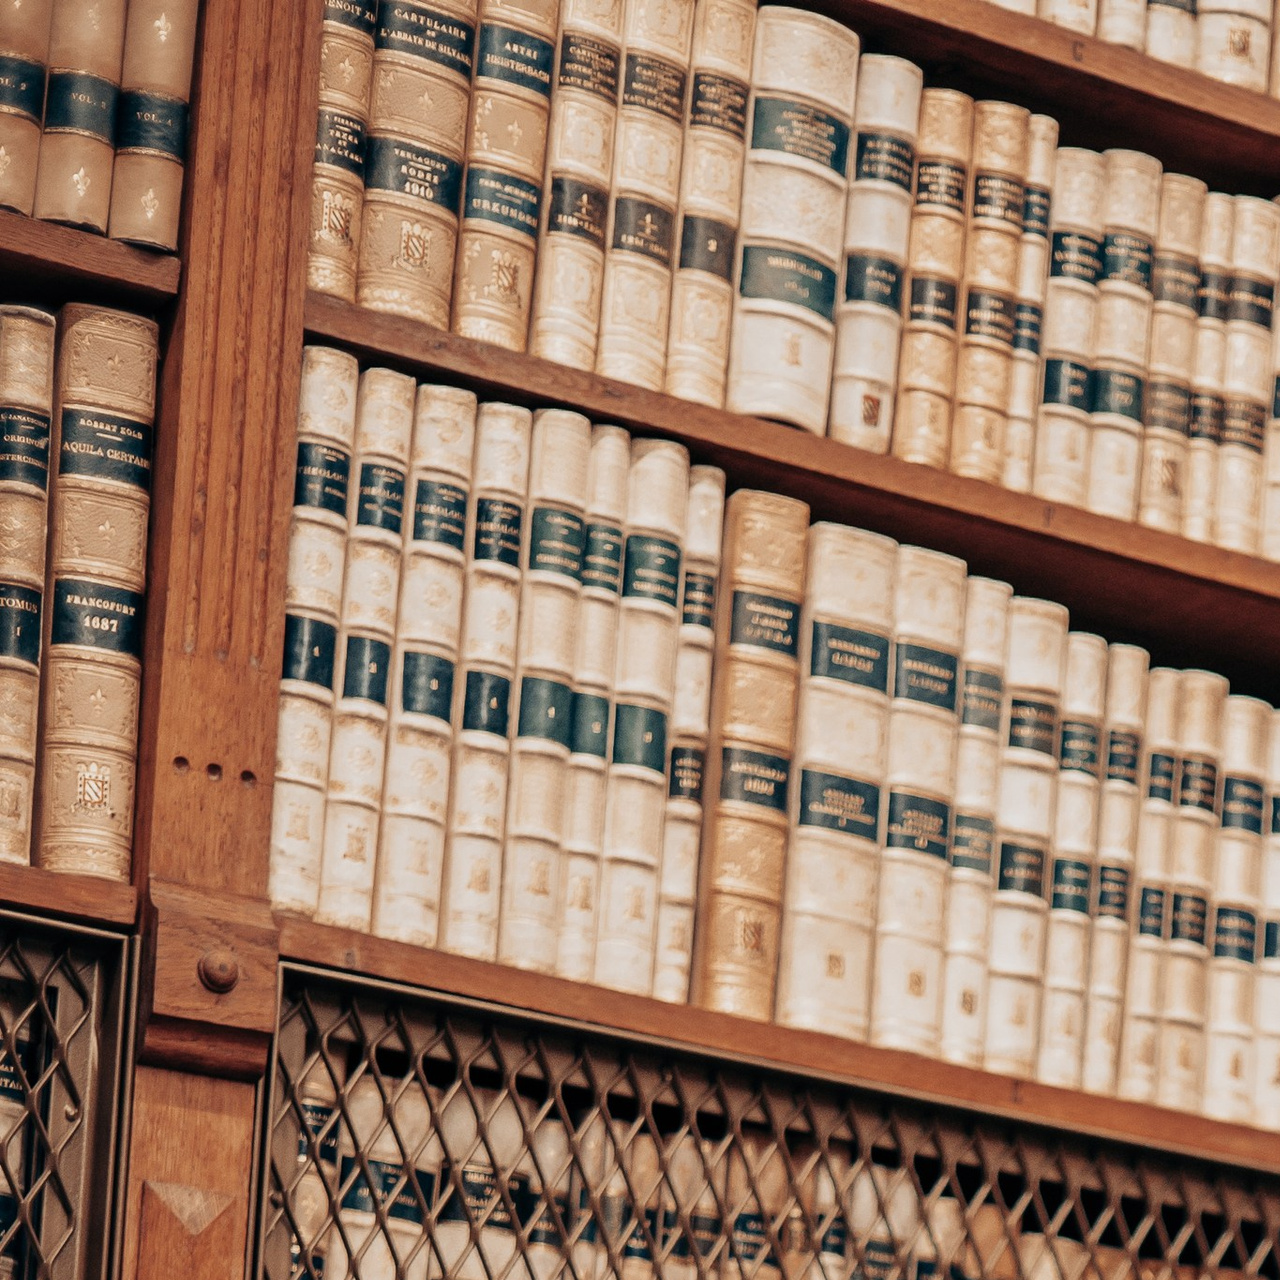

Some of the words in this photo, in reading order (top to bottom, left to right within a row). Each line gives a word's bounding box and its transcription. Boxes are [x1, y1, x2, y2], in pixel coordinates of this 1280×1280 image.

[394, 8, 467, 40] CARTULAIRE
[71, 92, 97, 106] VOL.
[136, 111, 162, 123] VOL.
[404, 181, 434, 200] 1910
[62, 441, 105, 458] AQUILA
[0, 597, 38, 614] TOMUS
[66, 594, 136, 617] FRANCOFURT
[83, 614, 119, 633] 1687
